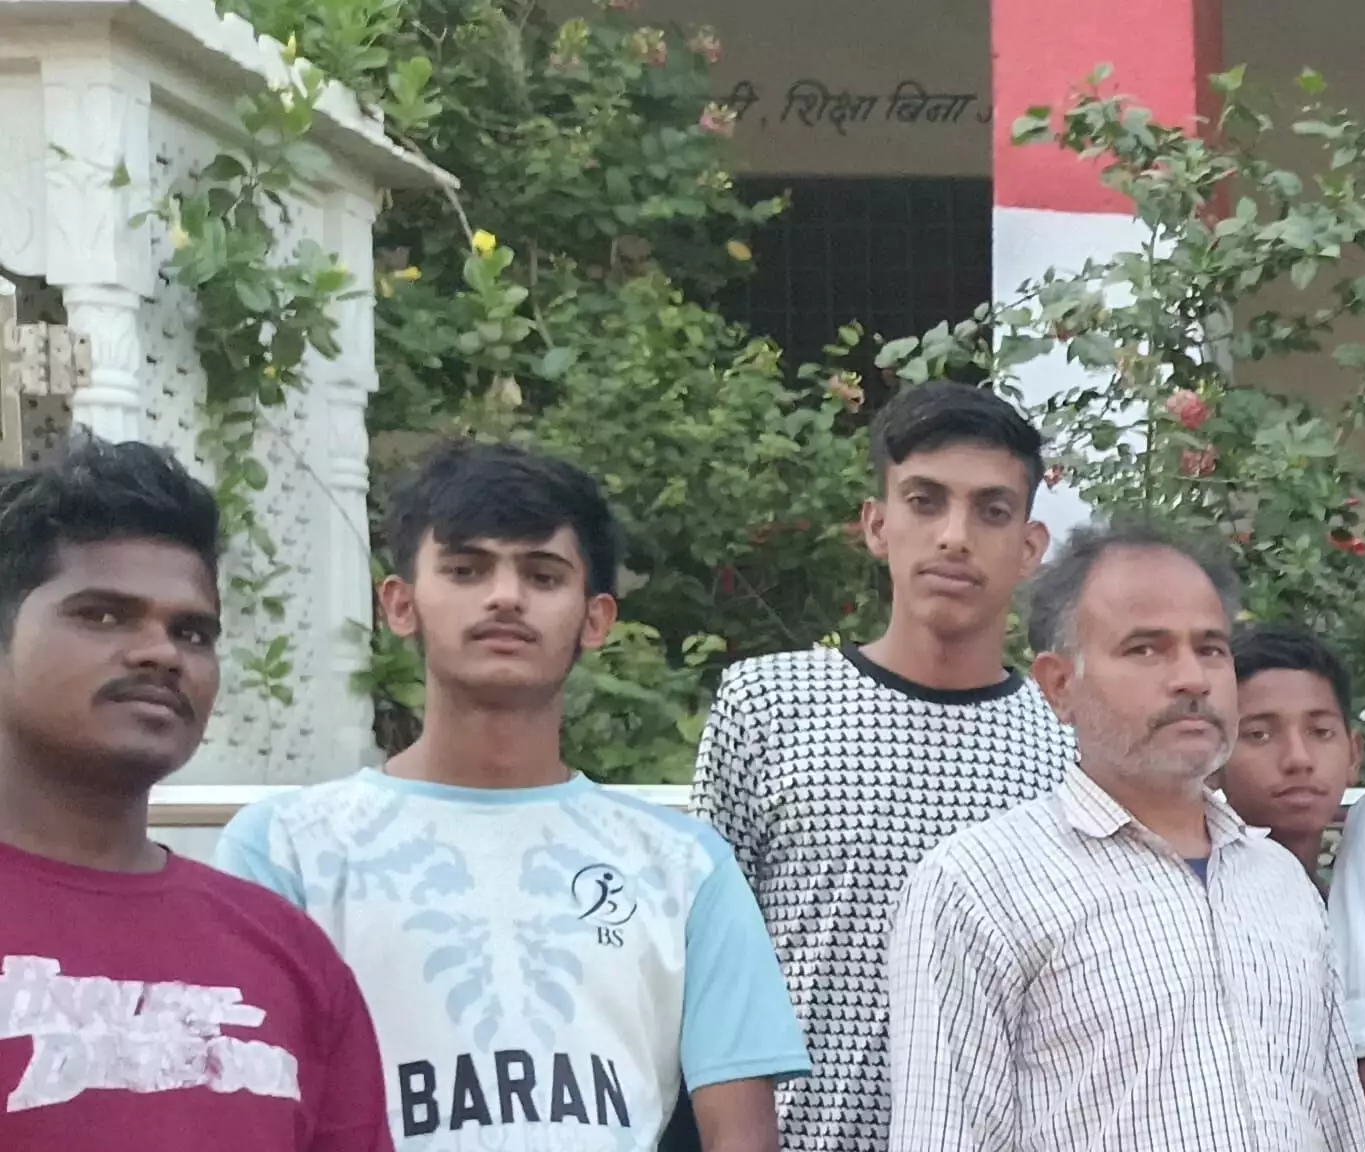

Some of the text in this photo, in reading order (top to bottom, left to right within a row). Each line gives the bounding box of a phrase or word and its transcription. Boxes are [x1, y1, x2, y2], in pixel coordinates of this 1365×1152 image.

[779, 79, 882, 136] शिक्षा
[886, 80, 978, 123] बिना
[597, 925, 625, 949] BS
[397, 1049, 632, 1138] BARAN
